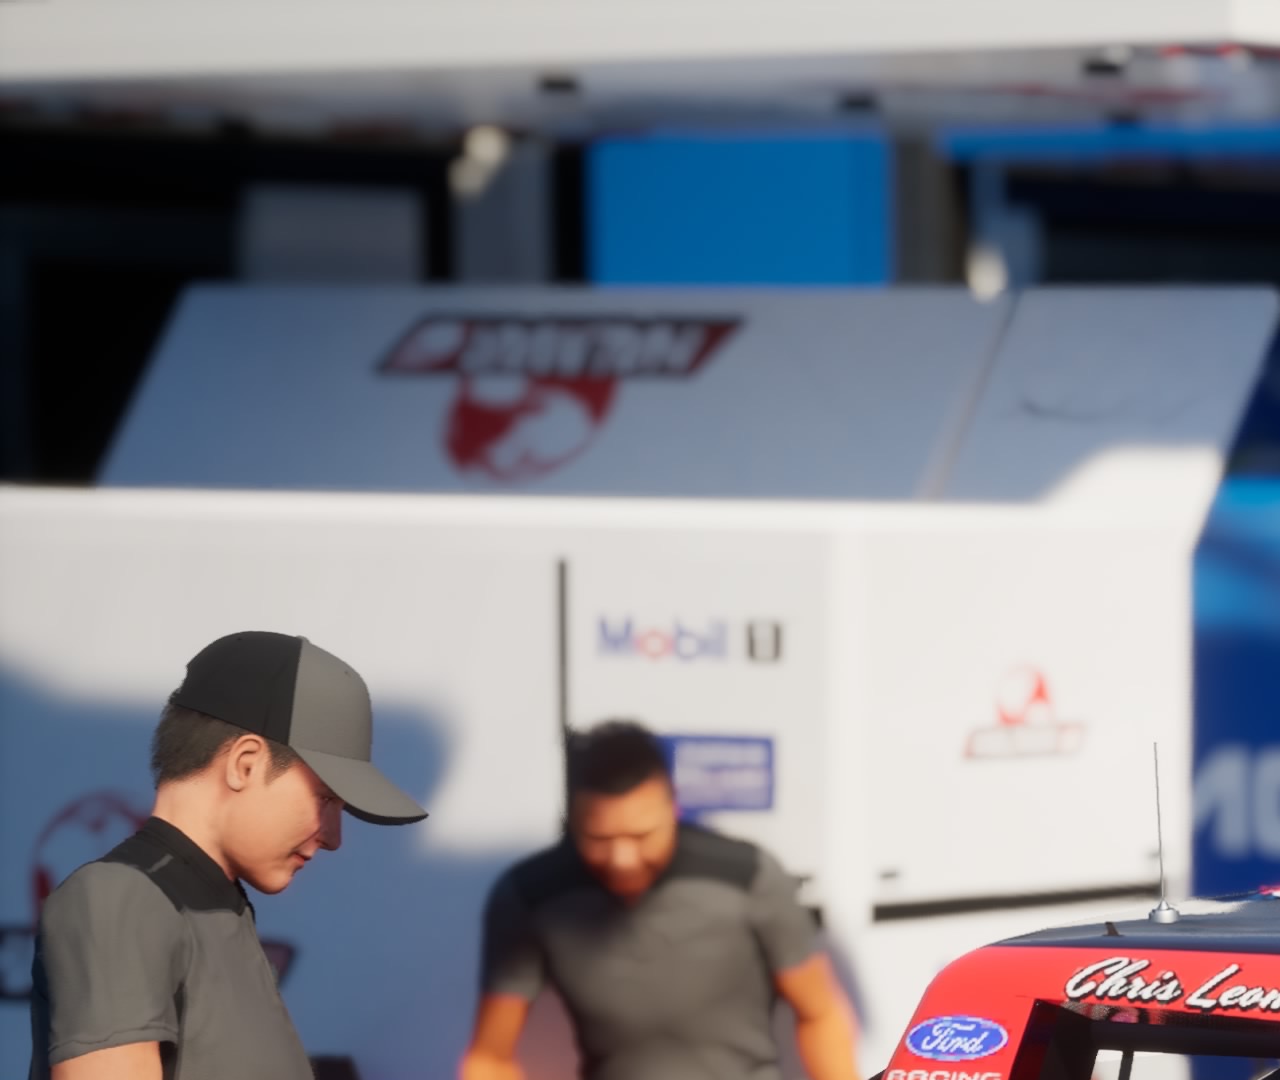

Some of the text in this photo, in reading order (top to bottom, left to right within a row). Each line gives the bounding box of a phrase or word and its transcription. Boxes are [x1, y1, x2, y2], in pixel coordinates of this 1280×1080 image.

[597, 614, 726, 663] Mobil
[1065, 956, 1182, 1004] Chris
[920, 1021, 989, 1054] Ford
